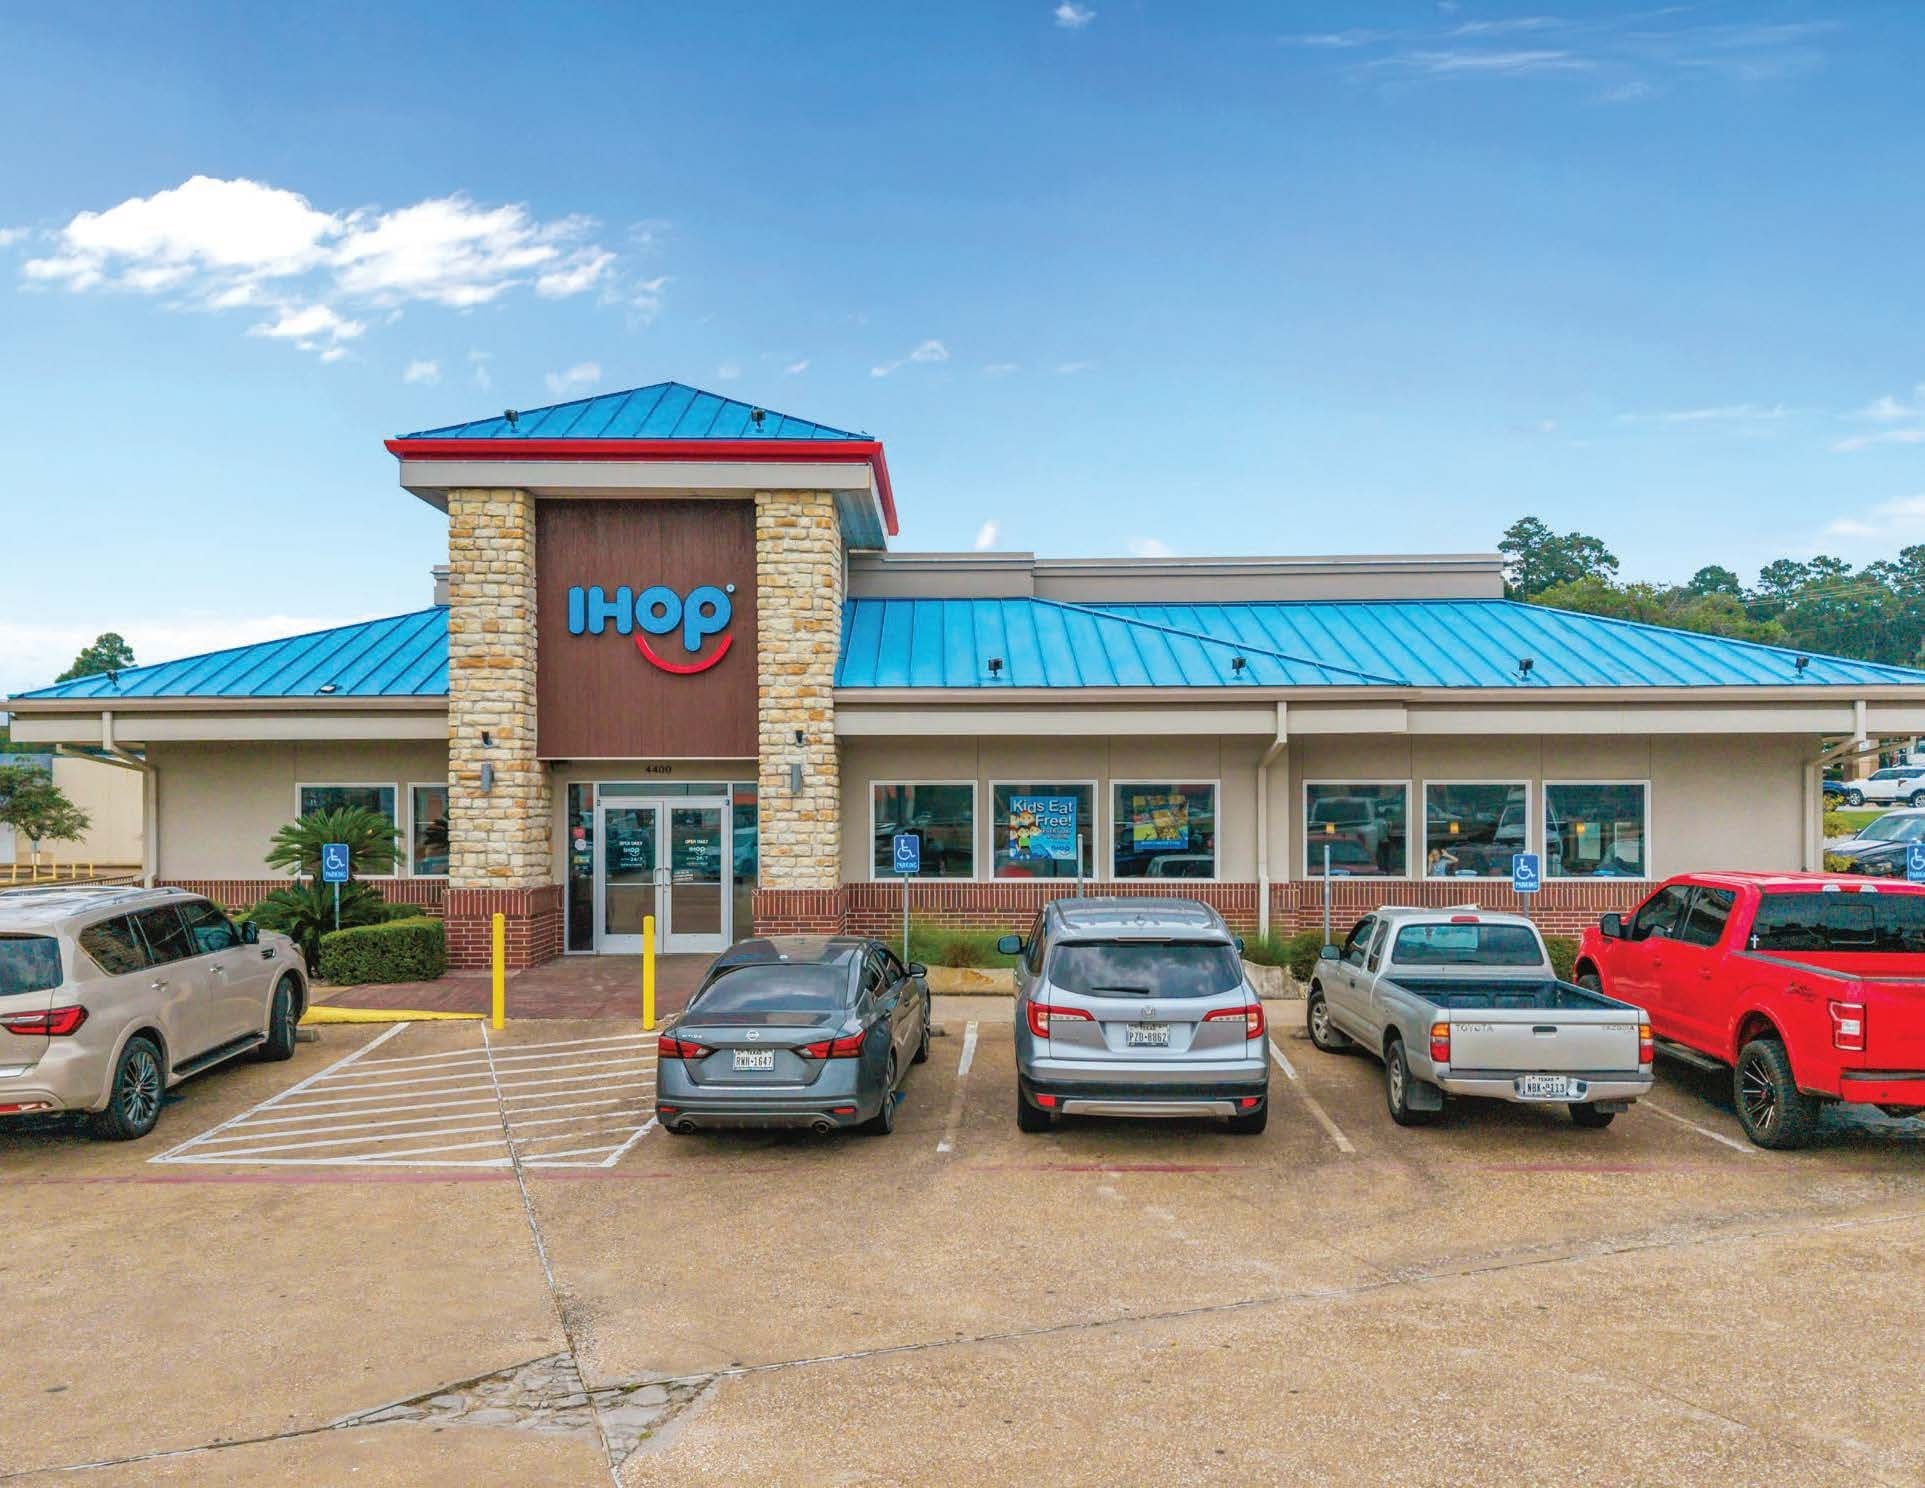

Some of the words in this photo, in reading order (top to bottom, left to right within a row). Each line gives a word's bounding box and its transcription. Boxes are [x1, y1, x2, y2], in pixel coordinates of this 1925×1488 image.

[568, 585, 732, 652] IHOP
[1013, 799, 1045, 813] Kids
[1048, 799, 1073, 814] Eat
[1035, 814, 1072, 827] Free!
[1515, 881, 1537, 889] PARKING
[1455, 1024, 1494, 1032] TOYOTA
